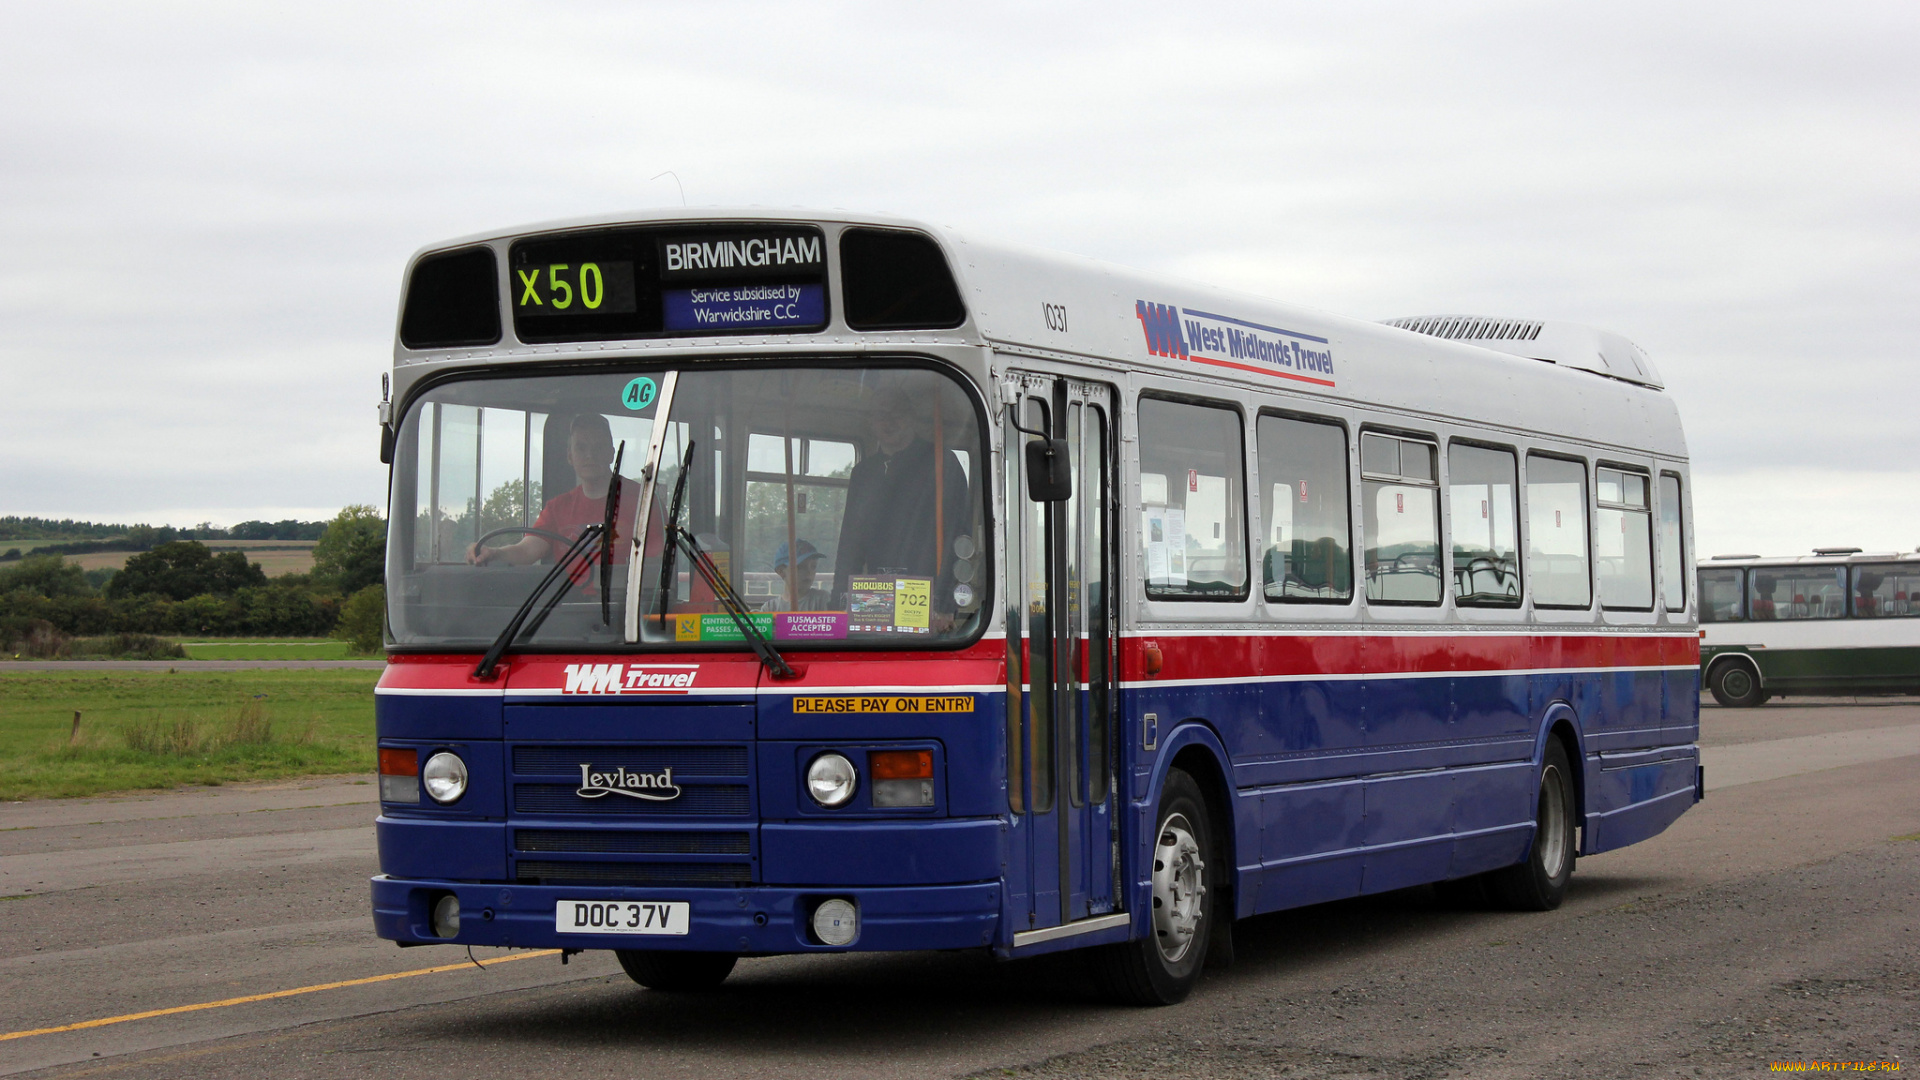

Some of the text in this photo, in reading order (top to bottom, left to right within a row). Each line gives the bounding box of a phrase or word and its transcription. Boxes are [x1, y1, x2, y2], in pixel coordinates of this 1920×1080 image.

[666, 236, 821, 271] BIRMINGHAM
[690, 284, 801, 303] Service subsidised by
[694, 303, 800, 323] Warwickshire C.C.
[1042, 302, 1068, 333] 1037
[1184, 319, 1334, 375] West Midlands Travel
[627, 383, 652, 403] AG
[852, 582, 895, 591] SHOWBUS
[900, 593, 928, 607] 702
[702, 617, 754, 625] CENTROCRDS
[787, 616, 837, 624] BUSMASTER
[791, 624, 832, 632] ACCEPTED
[625, 670, 697, 688] Travel
[796, 697, 972, 712] PLEASE PAY ON ENTRY
[576, 763, 681, 800] Leyland
[574, 903, 671, 928] DOC 37V
